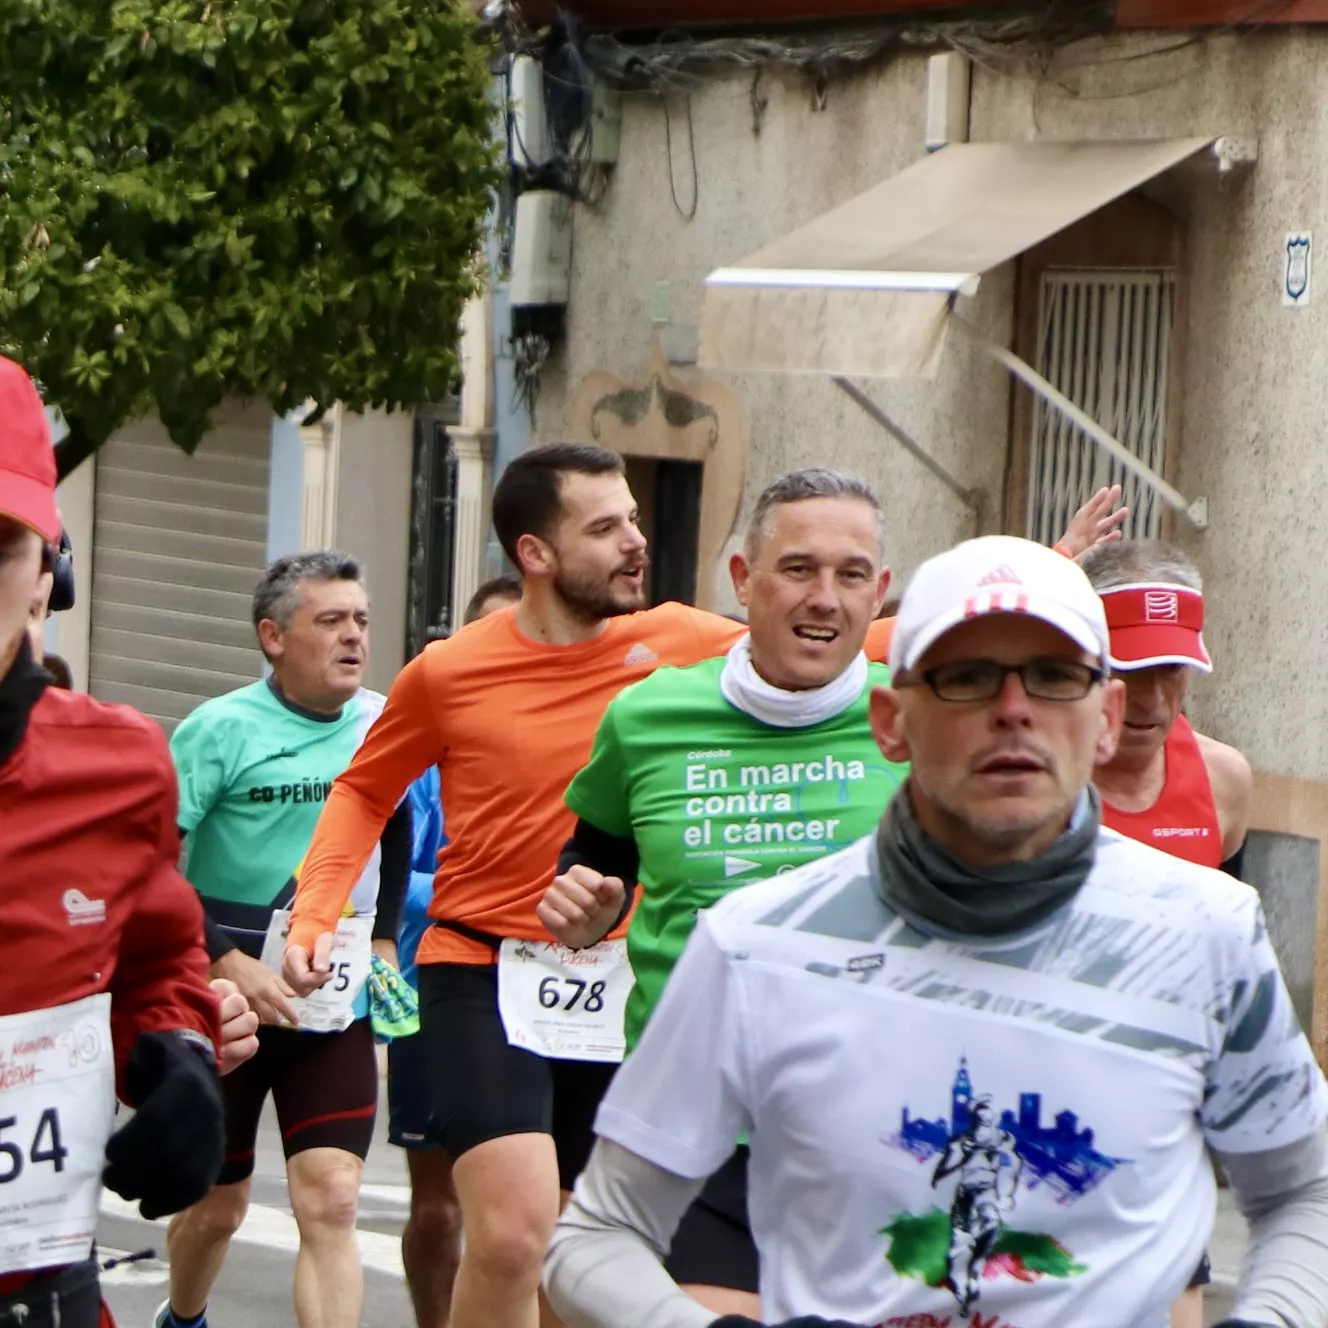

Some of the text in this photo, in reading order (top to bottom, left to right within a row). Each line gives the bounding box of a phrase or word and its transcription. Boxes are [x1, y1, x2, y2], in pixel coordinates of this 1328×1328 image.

[686, 754, 865, 791] En marcha
[686, 790, 792, 816] contra
[684, 816, 840, 846] el cáncer
[539, 976, 607, 1013] 678
